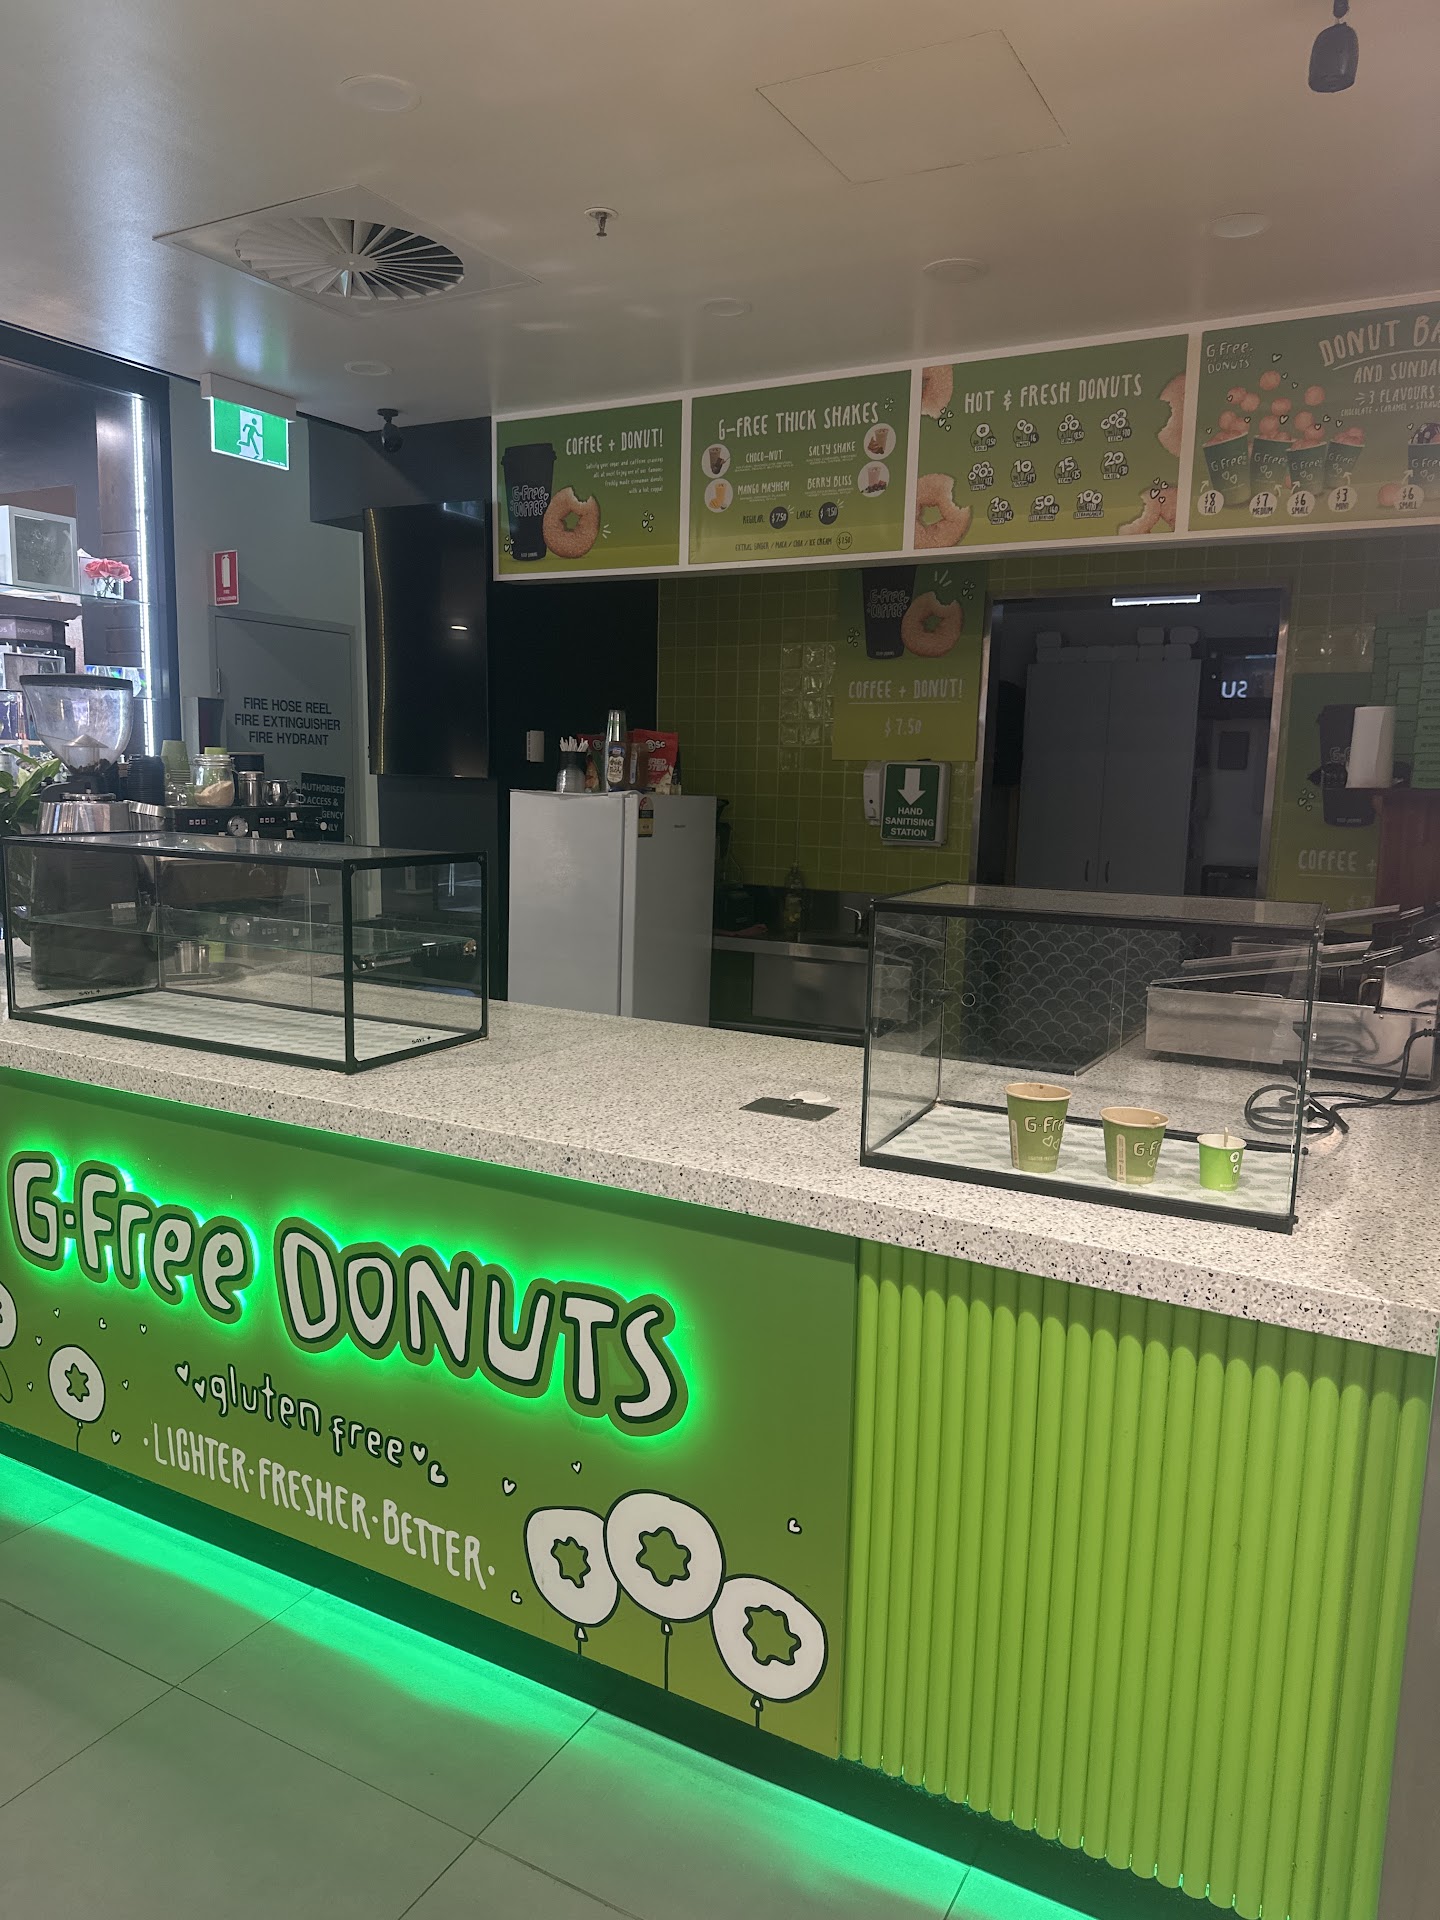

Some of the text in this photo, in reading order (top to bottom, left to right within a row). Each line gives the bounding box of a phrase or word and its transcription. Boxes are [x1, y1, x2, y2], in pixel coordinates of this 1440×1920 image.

[1318, 320, 1400, 367] DONUT
[1207, 358, 1250, 374] DONUTS
[1353, 364, 1383, 384] AND
[964, 373, 1142, 414] HOT & FRESH DONUTS
[1368, 385, 1435, 404] 3 FLAVOURS
[1340, 406, 1372, 417] CHOCOLATE
[1380, 403, 1408, 414] CARAMEL
[718, 401, 879, 441] G-FREE THICK SHAKES
[565, 434, 603, 456] COFFEE
[620, 427, 664, 451] DONUT!
[808, 441, 856, 457] SALTY SHAKE
[745, 449, 784, 464] CHOCO-NUT
[1058, 456, 1075, 473] 15
[737, 482, 760, 496] MANGO
[761, 480, 790, 493] MAYHEM
[807, 474, 852, 490] BERRY BLISS
[1204, 492, 1216, 506] $8
[1256, 492, 1269, 507] $7
[1295, 492, 1306, 506] $6
[1336, 488, 1348, 502] $3
[1402, 487, 1415, 500] $6
[1204, 505, 1217, 514] TALL
[1252, 507, 1273, 516] MEDIUM
[1291, 505, 1309, 515] SMALL
[1398, 501, 1417, 510] SMALL
[870, 602, 905, 619] COFFEE
[17, 627, 45, 636] PAPYRUS
[848, 679, 891, 699] COFFEE
[913, 678, 963, 699] DONUT!
[243, 697, 332, 715] FIRE HOSE REEL
[234, 713, 341, 731] FIRE EXTINGUISHER
[249, 731, 329, 746] FIRE HYDRANT
[301, 782, 345, 795] AUTHORISED
[307, 796, 339, 806] ACCESS &
[321, 810, 344, 820] GENCY
[897, 807, 923, 815] HAND
[884, 816, 934, 827] SANITISING
[890, 827, 927, 837] STATION
[1298, 849, 1358, 872] COFFEE
[281, 1227, 677, 1423] DONUTS
[210, 1363, 403, 1468] gluten free
